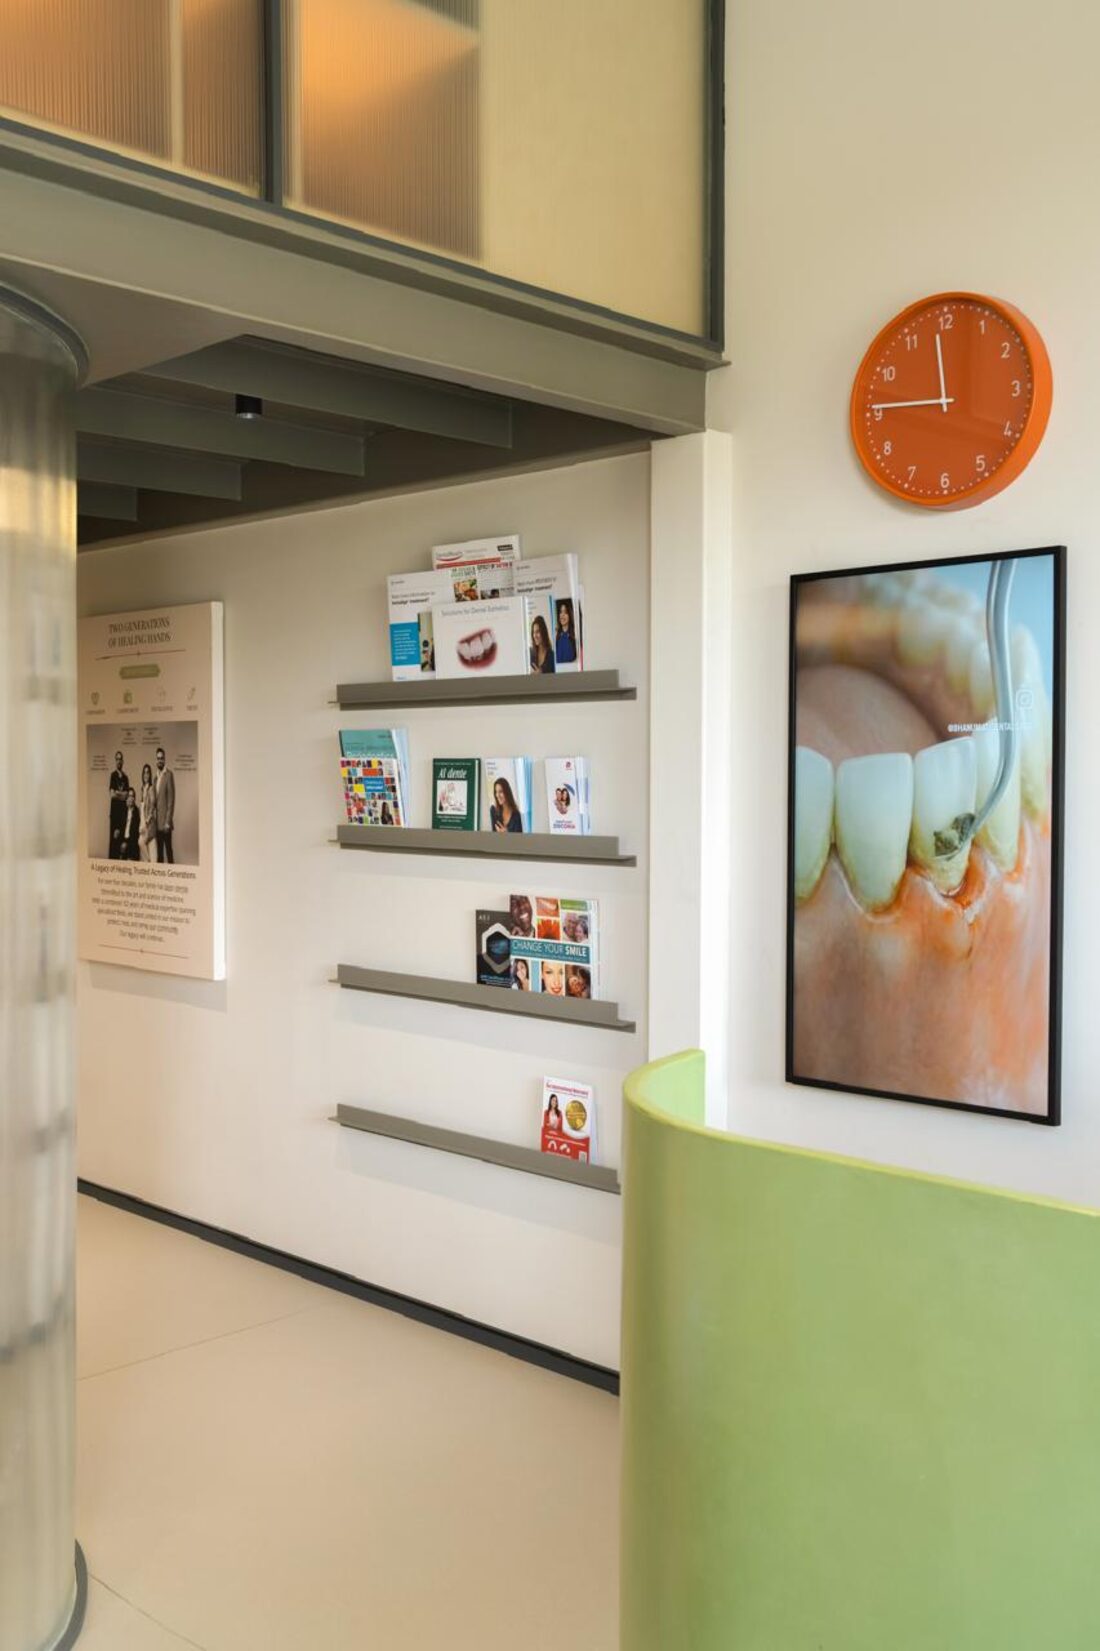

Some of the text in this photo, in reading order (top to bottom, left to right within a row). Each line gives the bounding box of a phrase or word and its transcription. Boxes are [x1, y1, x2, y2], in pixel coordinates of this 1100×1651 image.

[939, 314, 953, 330] 12
[979, 320, 985, 335] 1
[905, 334, 918, 350] 11
[1001, 342, 1010, 358] 2
[882, 366, 896, 381] 10
[1011, 380, 1020, 397] 3
[874, 405, 882, 420] 9
[1003, 421, 1012, 436] 4
[883, 441, 892, 454] 8
[976, 455, 986, 472] 5
[908, 466, 916, 480] 7
[940, 473, 950, 488] 6
[118, 634, 147, 647] HEALING
[438, 767, 467, 779] Al dente
[513, 940, 542, 953] CHANGE
[544, 943, 563, 954] YOUR
[565, 946, 587, 957] SMILE
